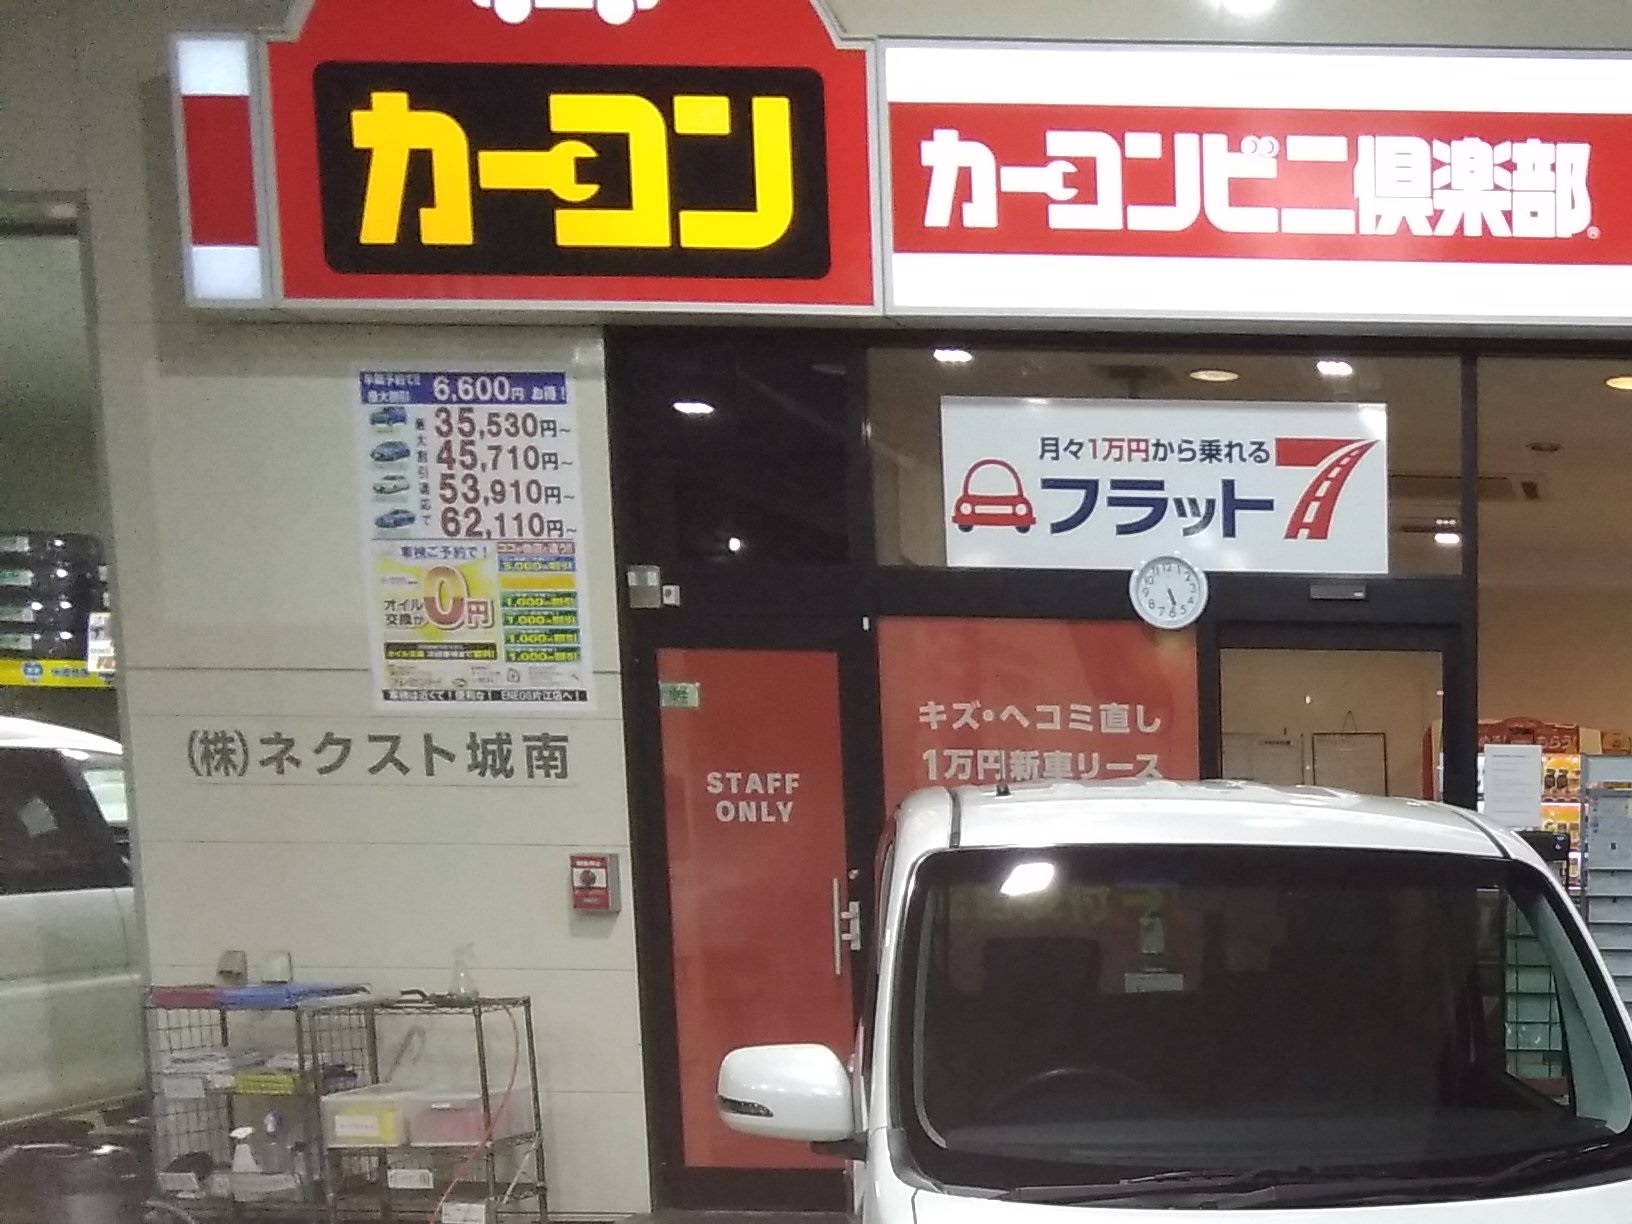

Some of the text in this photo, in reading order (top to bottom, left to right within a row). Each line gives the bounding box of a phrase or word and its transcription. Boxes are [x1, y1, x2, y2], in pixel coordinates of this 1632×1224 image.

[350, 91, 794, 250] カーコン
[920, 128, 1593, 239] カーコンビニ倶楽部
[433, 375, 525, 402] 6,600円
[1037, 436, 1271, 465] 月々1万円から乗れる
[918, 699, 1162, 735] キズ・ヘコミ直し
[187, 728, 570, 780] (株)ネクスト城南
[922, 747, 1164, 781] 1万円新車リース
[706, 771, 801, 795] STAFF
[715, 800, 794, 823] ONLY
